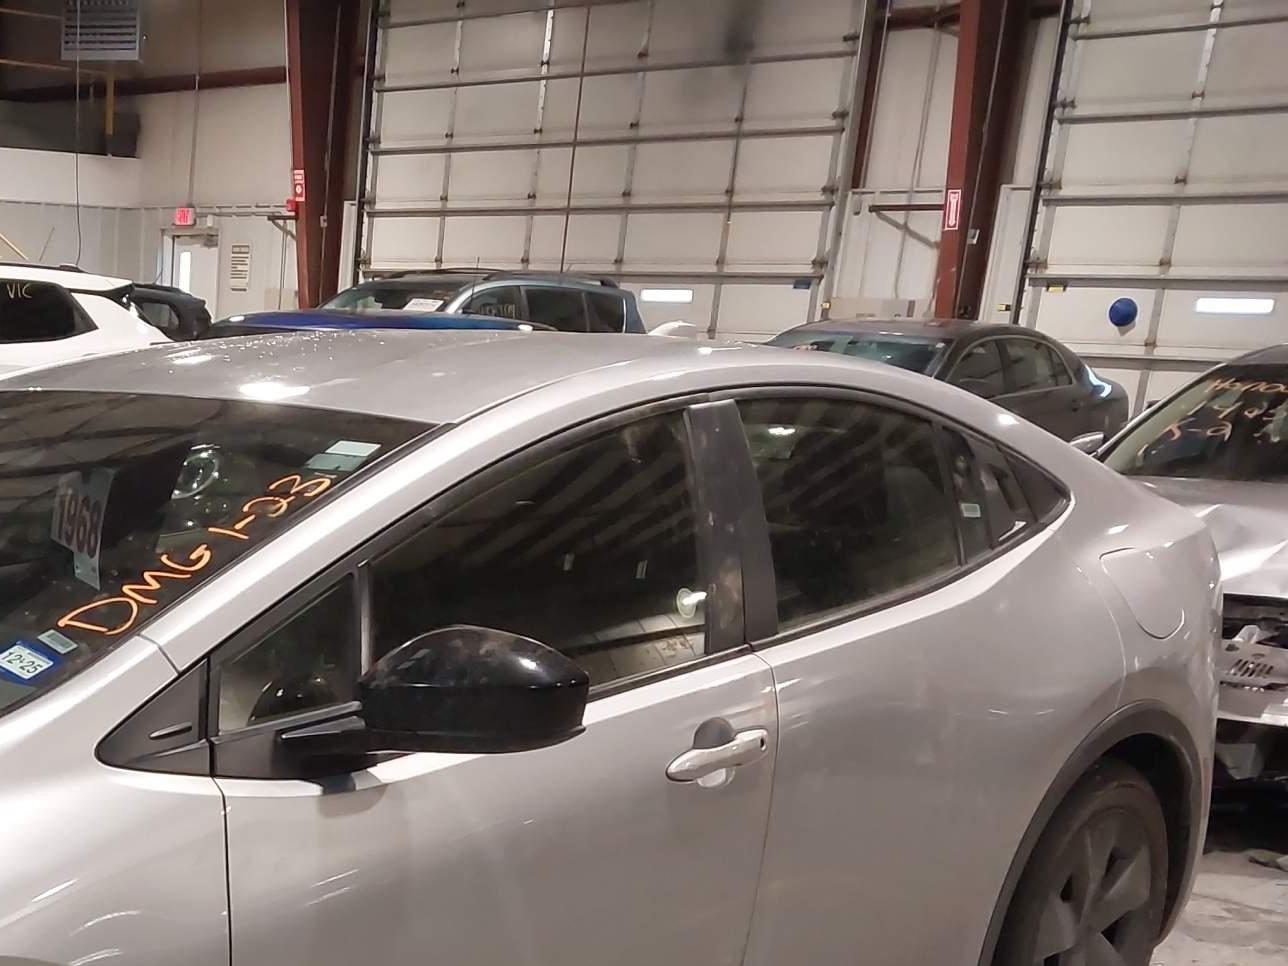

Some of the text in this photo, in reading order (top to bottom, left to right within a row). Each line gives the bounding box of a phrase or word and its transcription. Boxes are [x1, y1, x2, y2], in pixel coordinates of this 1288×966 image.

[6, 282, 33, 299] VIC
[57, 492, 101, 559] 1968
[56, 543, 212, 636] DMG
